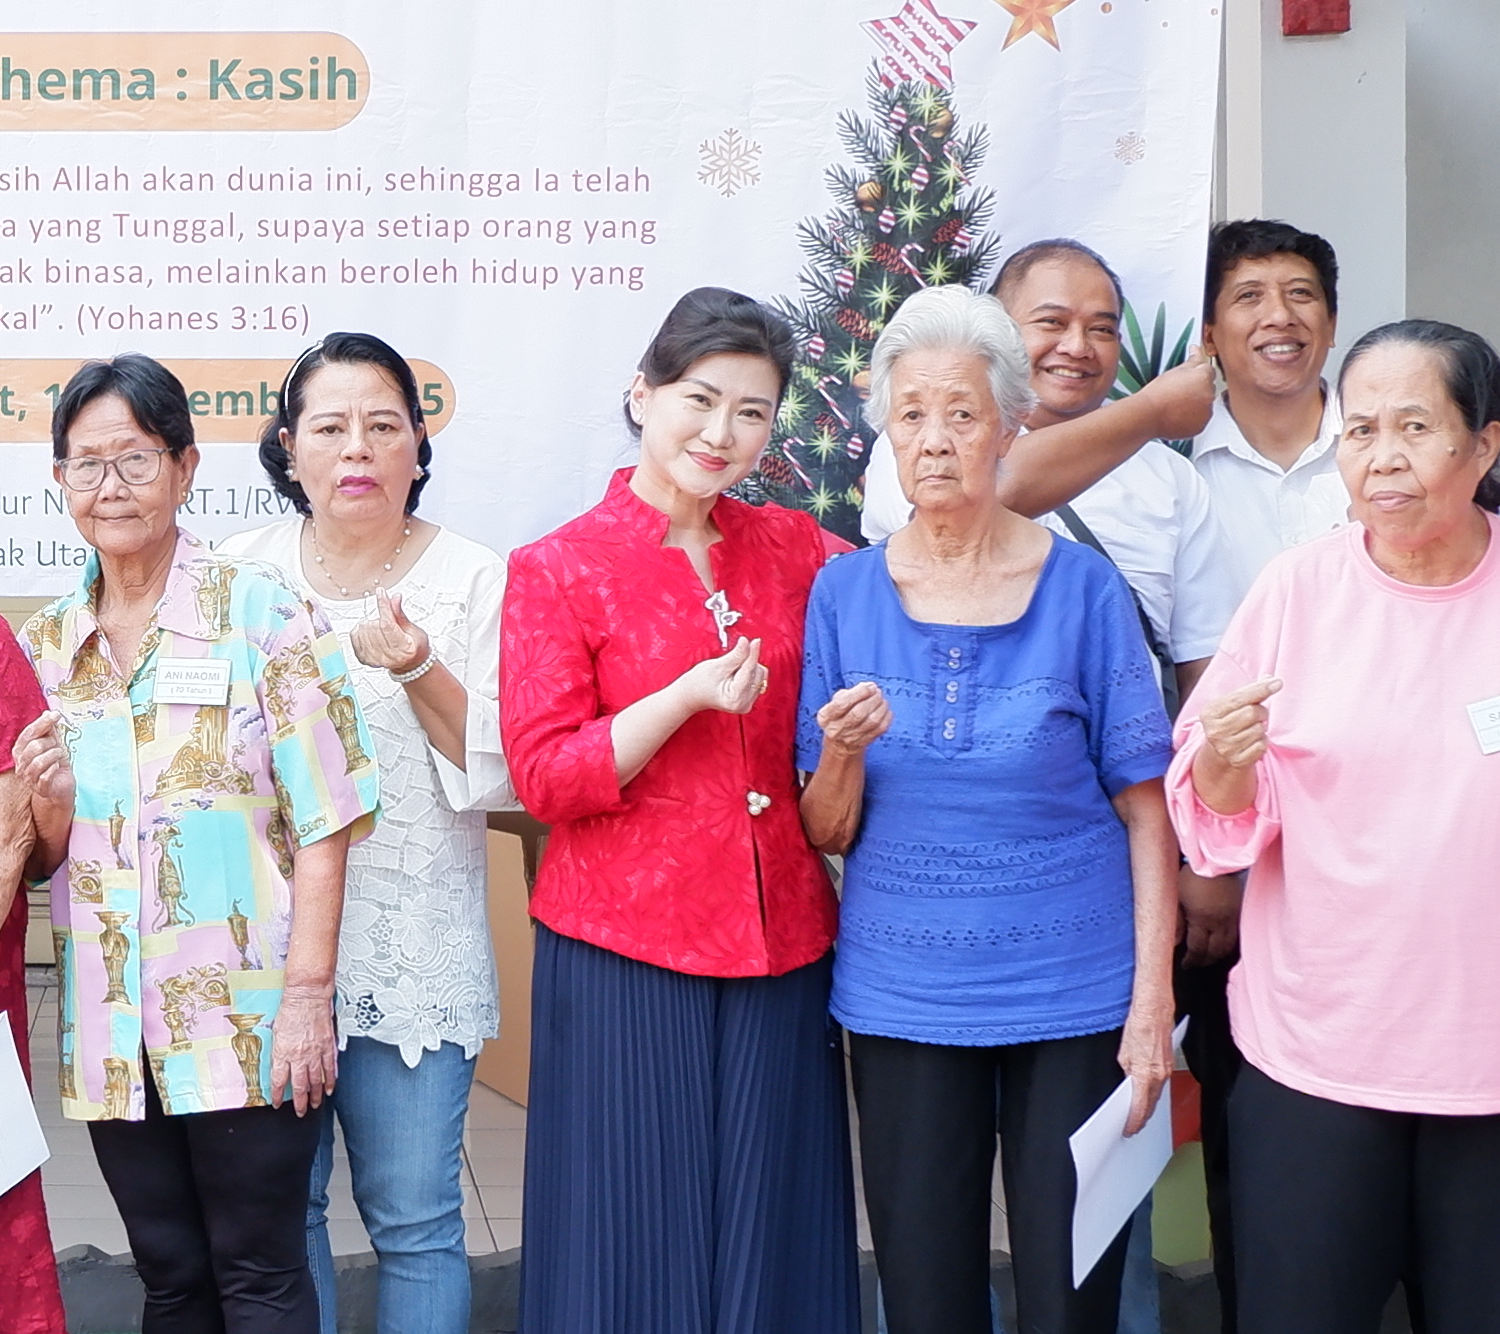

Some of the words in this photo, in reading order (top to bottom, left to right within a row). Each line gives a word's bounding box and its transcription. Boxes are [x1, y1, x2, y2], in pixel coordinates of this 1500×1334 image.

[208, 55, 358, 101] Kasih
[52, 164, 129, 192] Allah
[142, 165, 214, 192] akan
[227, 165, 313, 192] dunia
[326, 166, 372, 197] ini,
[384, 165, 520, 198] sehingga
[571, 166, 650, 193] telah
[28, 219, 102, 244] yang
[112, 211, 244, 244] Tunggal,
[257, 219, 364, 244] supaya
[377, 212, 470, 244] setiap
[482, 219, 572, 245] orang
[583, 219, 657, 245] yang
[45, 257, 153, 289] binasa,
[167, 257, 326, 284] melainkan
[341, 257, 458, 284] beroleh
[472, 257, 559, 291] hidup
[570, 266, 645, 292] yang
[77, 303, 219, 336] (Yohanes
[231, 303, 309, 337] 3:16)
[164, 671, 183, 680] ANI
[184, 671, 221, 681] NAOMI
